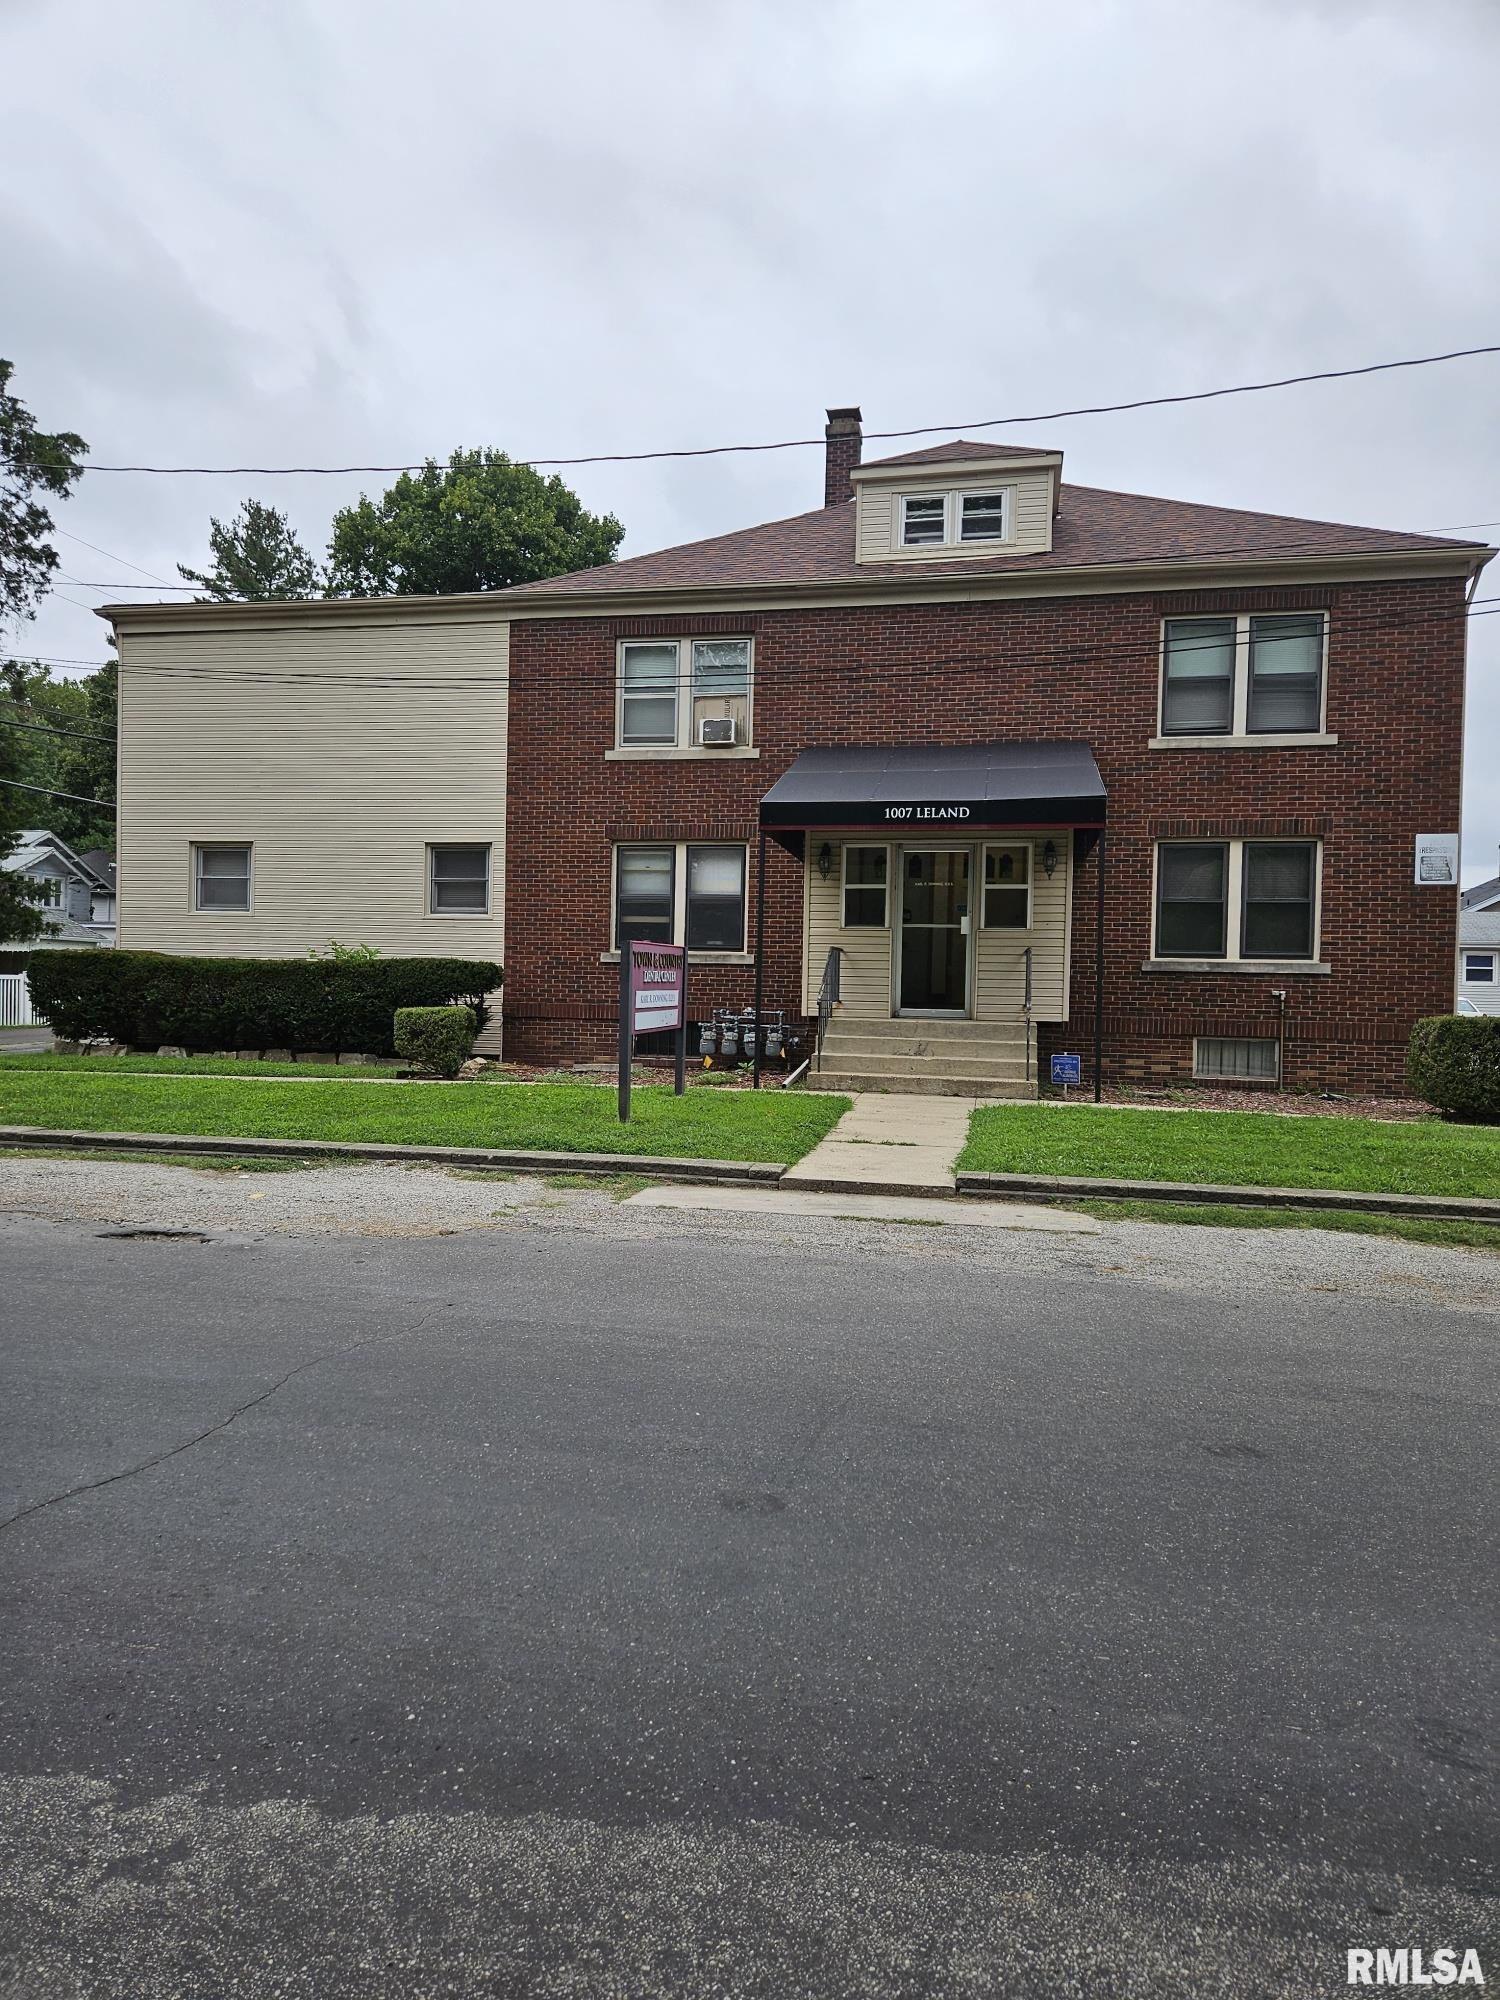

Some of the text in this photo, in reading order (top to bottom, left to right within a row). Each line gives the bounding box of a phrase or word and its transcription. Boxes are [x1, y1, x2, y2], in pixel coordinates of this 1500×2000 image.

[884, 807, 970, 819] 1007 LELAND
[632, 950, 652, 969] TOWN
[659, 953, 684, 970] COUNTRY
